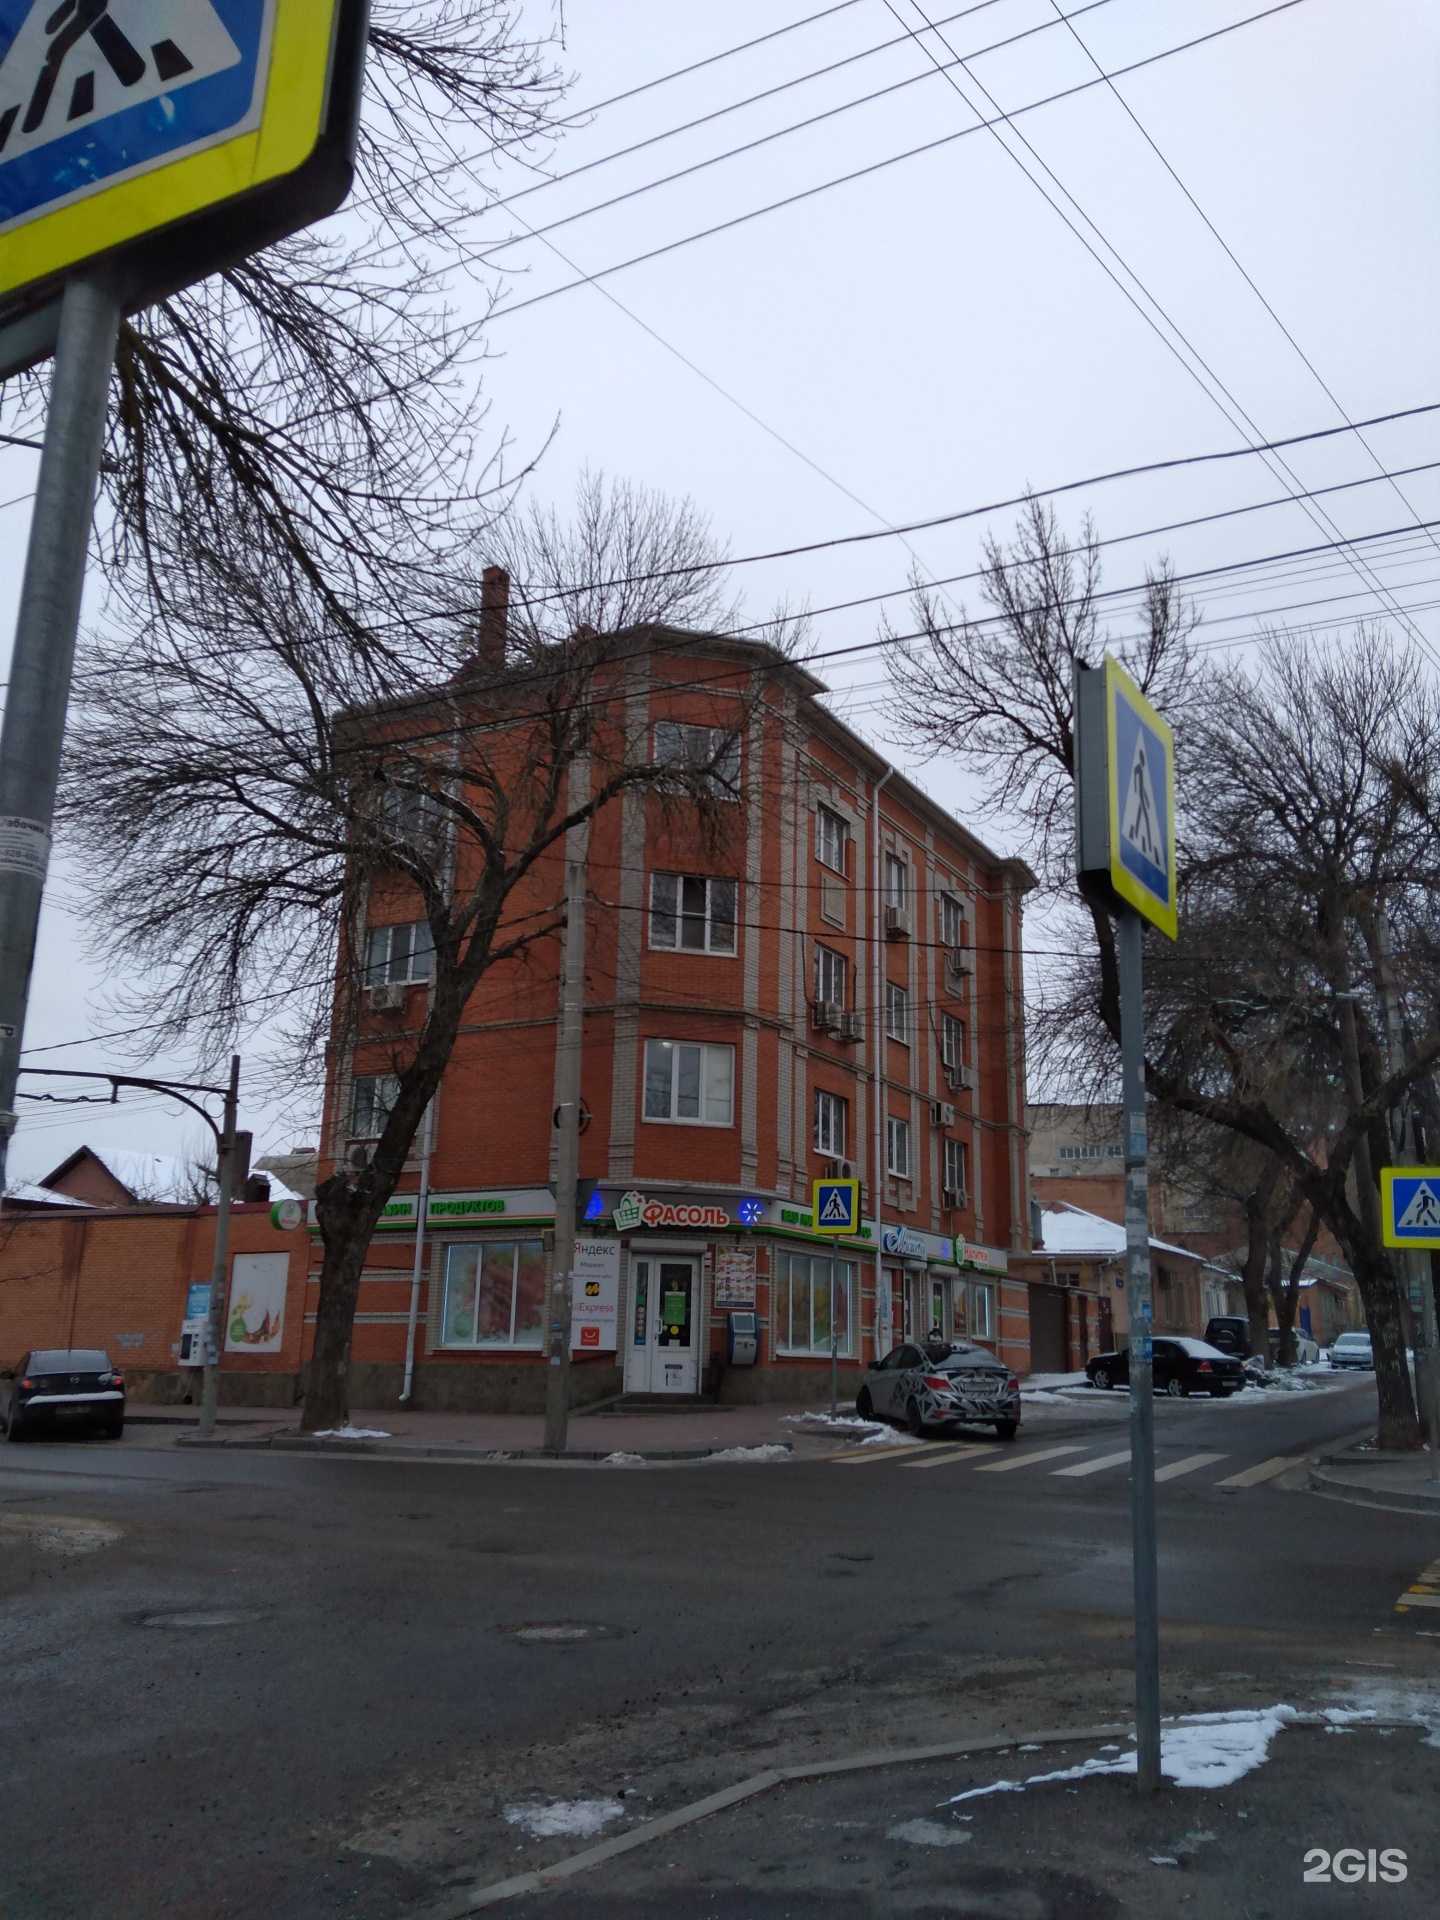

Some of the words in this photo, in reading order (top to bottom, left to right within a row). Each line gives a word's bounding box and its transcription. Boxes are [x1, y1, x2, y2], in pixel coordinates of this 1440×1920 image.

[430, 1199, 505, 1215] ПРОДУКТОВ
[642, 1200, 729, 1226] ФАСОЛЬ
[575, 1242, 616, 1256] Яндекс
